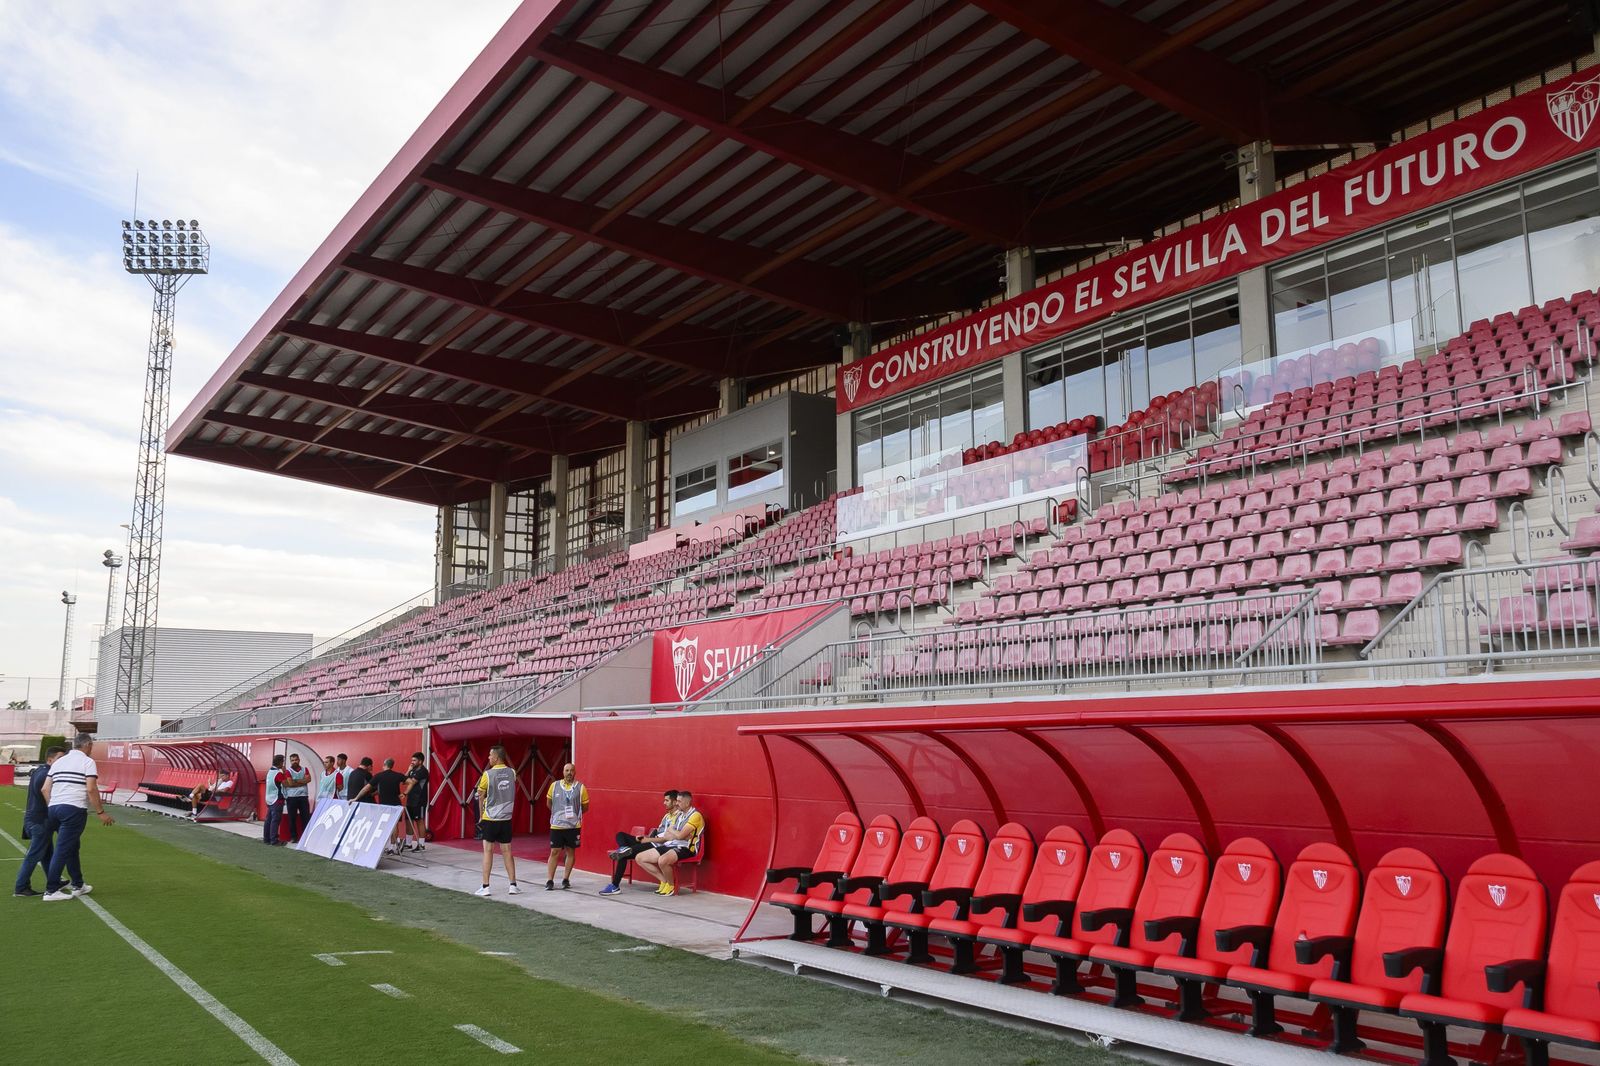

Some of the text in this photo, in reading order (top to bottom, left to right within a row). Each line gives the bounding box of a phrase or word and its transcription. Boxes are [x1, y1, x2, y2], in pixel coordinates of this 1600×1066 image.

[868, 116, 1527, 389] CONSTRUYENDO EL SEVILLA DEL FUTURO
[365, 813, 391, 852] F
